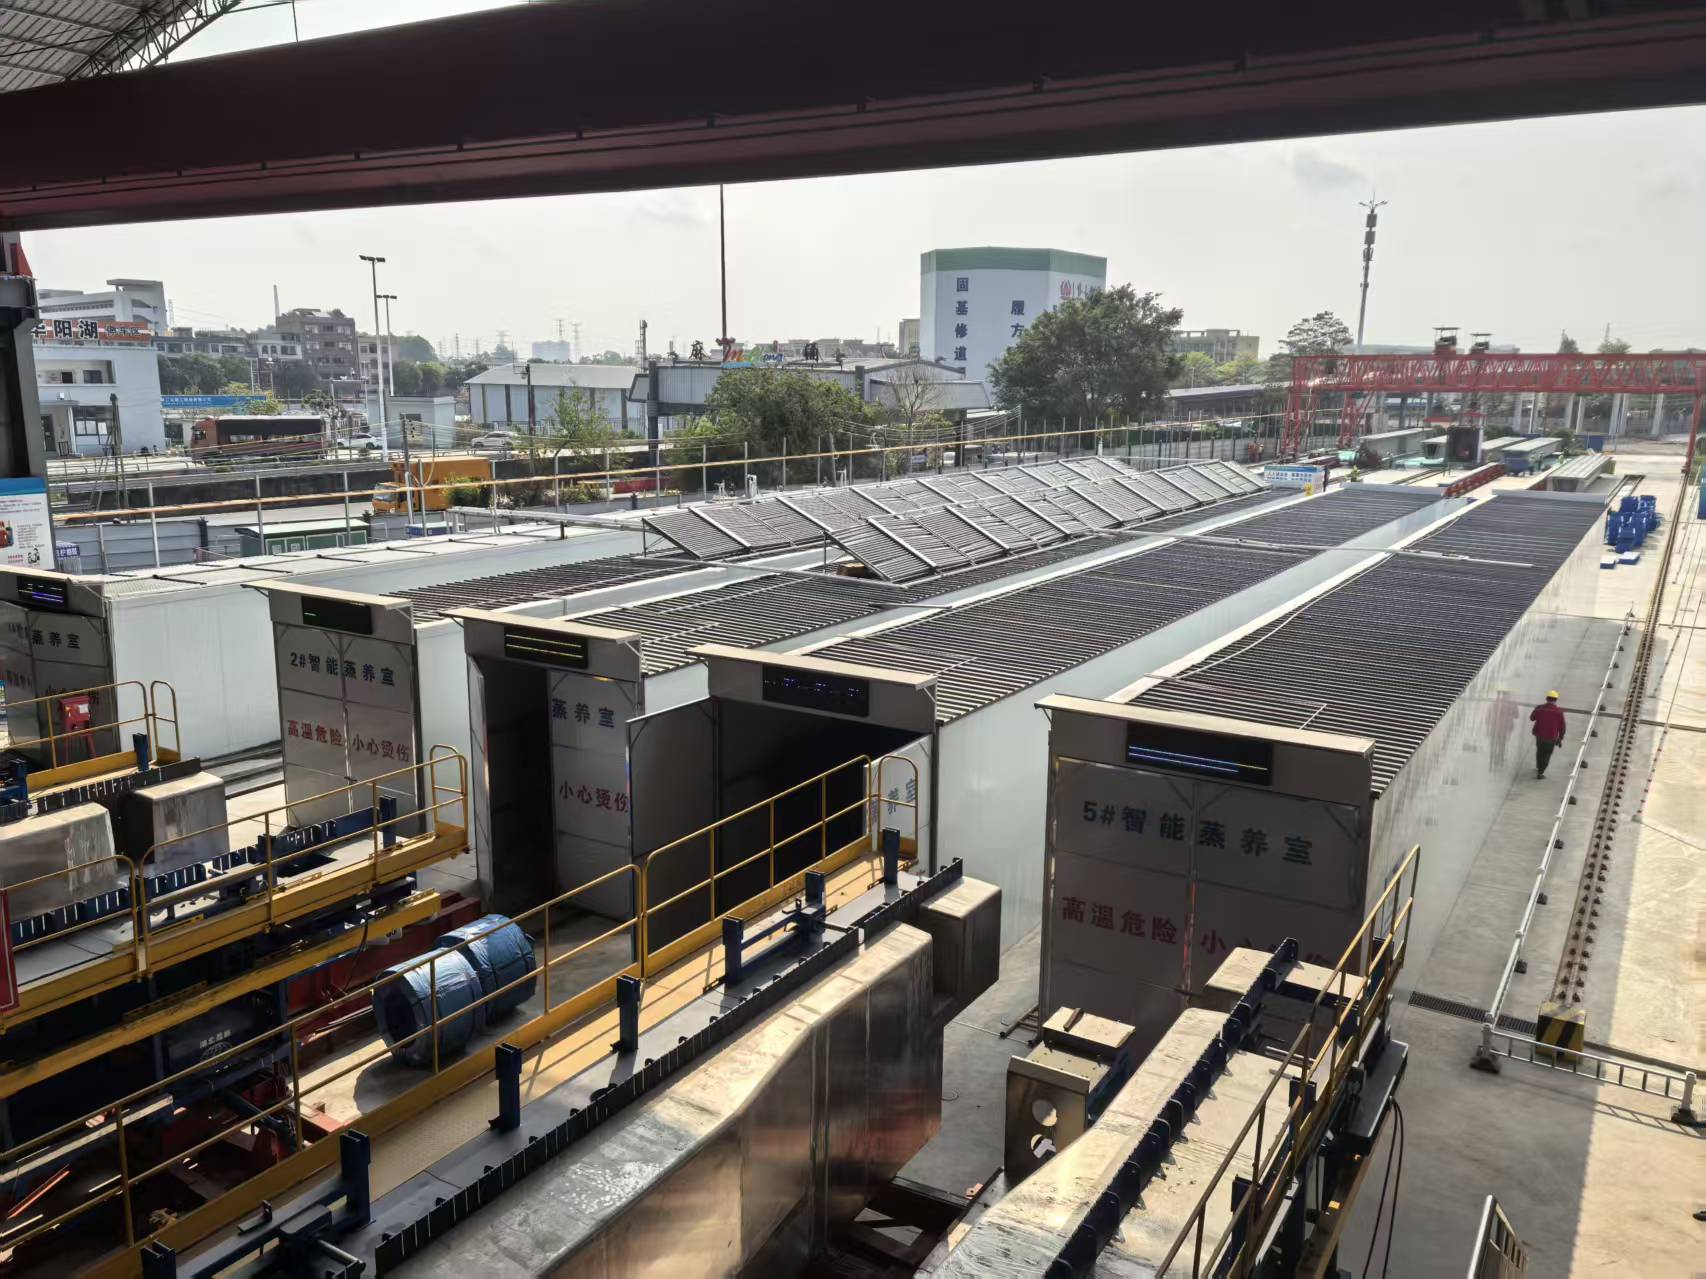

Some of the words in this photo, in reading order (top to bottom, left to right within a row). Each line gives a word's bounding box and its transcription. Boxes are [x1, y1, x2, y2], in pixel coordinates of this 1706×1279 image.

[954, 277, 969, 361] 固基修道
[552, 698, 615, 728] 蒸养室
[288, 719, 343, 746] 高温危险
[352, 733, 410, 762] 小心烫伤
[1082, 800, 1313, 866] 5#智能蒸养室
[1062, 896, 1178, 945] 高温危险
